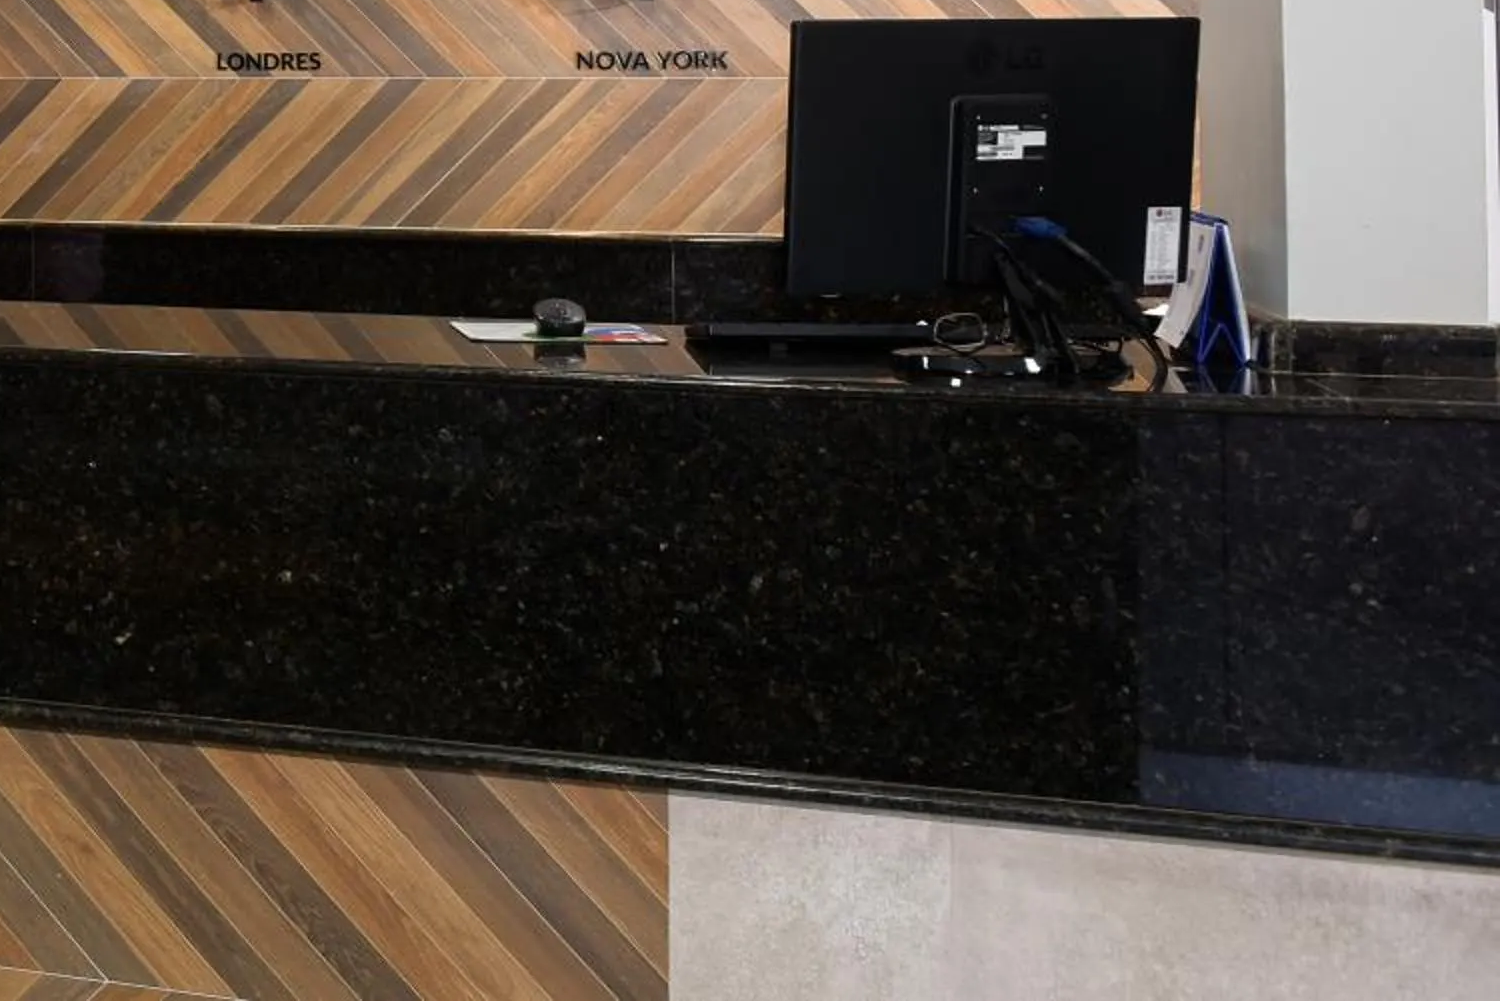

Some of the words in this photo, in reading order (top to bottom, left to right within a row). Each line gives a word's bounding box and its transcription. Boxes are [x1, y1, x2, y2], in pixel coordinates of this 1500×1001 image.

[216, 52, 321, 72] LONDRES
[576, 51, 650, 70] NOVA
[658, 50, 728, 70] YORK
